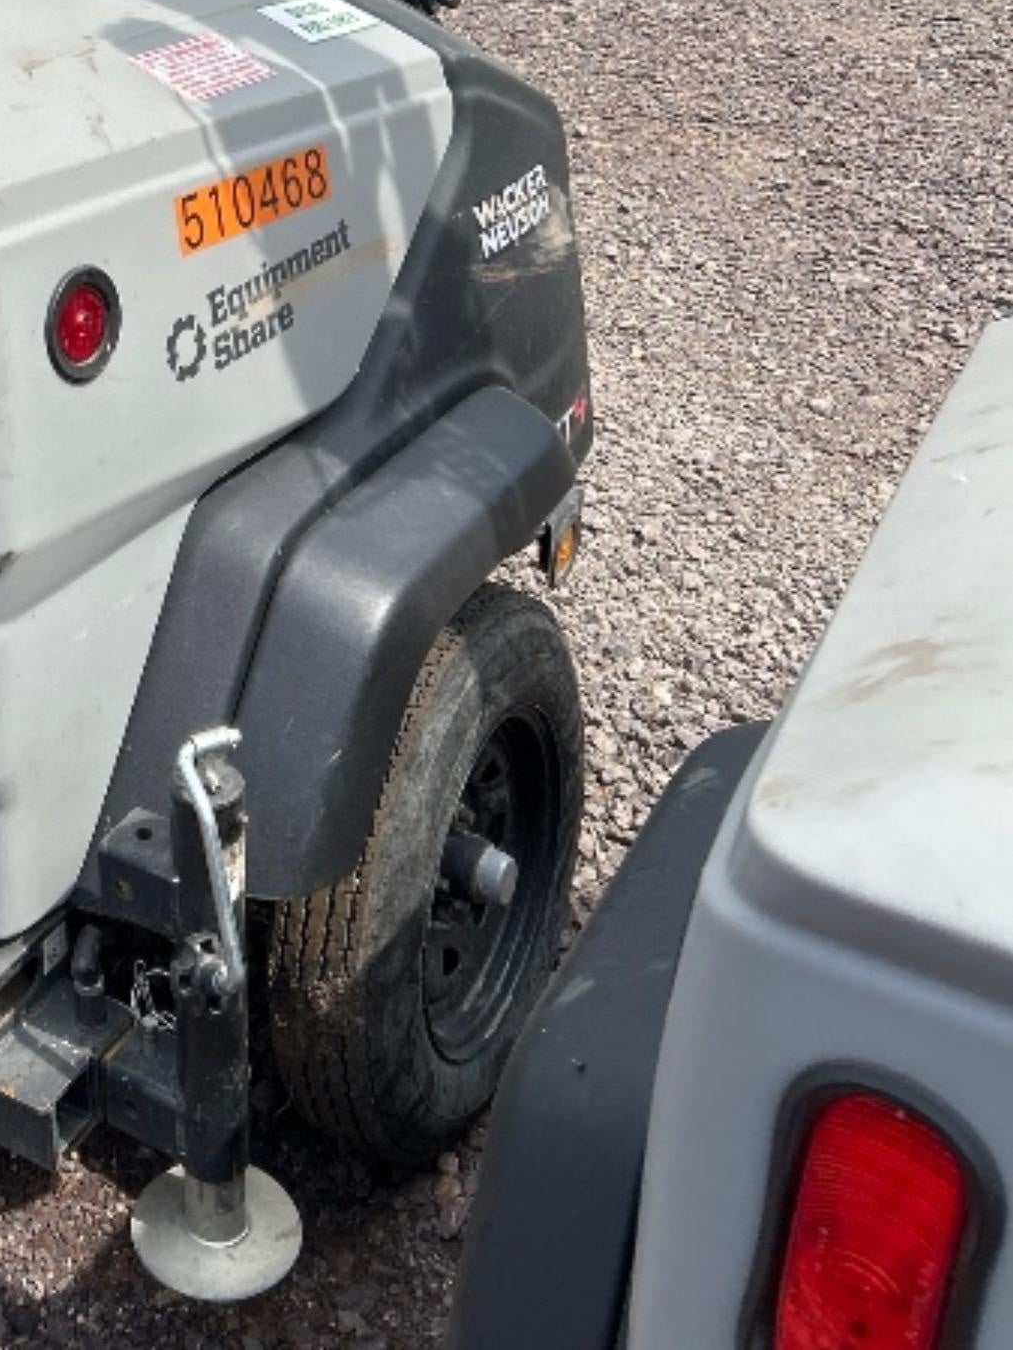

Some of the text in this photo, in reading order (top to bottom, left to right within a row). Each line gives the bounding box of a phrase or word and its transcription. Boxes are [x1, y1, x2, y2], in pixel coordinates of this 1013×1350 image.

[181, 149, 327, 249] 510468
[472, 163, 547, 229] WACKER
[479, 193, 550, 258] NEUSON
[206, 218, 351, 328] Equipment
[211, 302, 295, 370] Share
